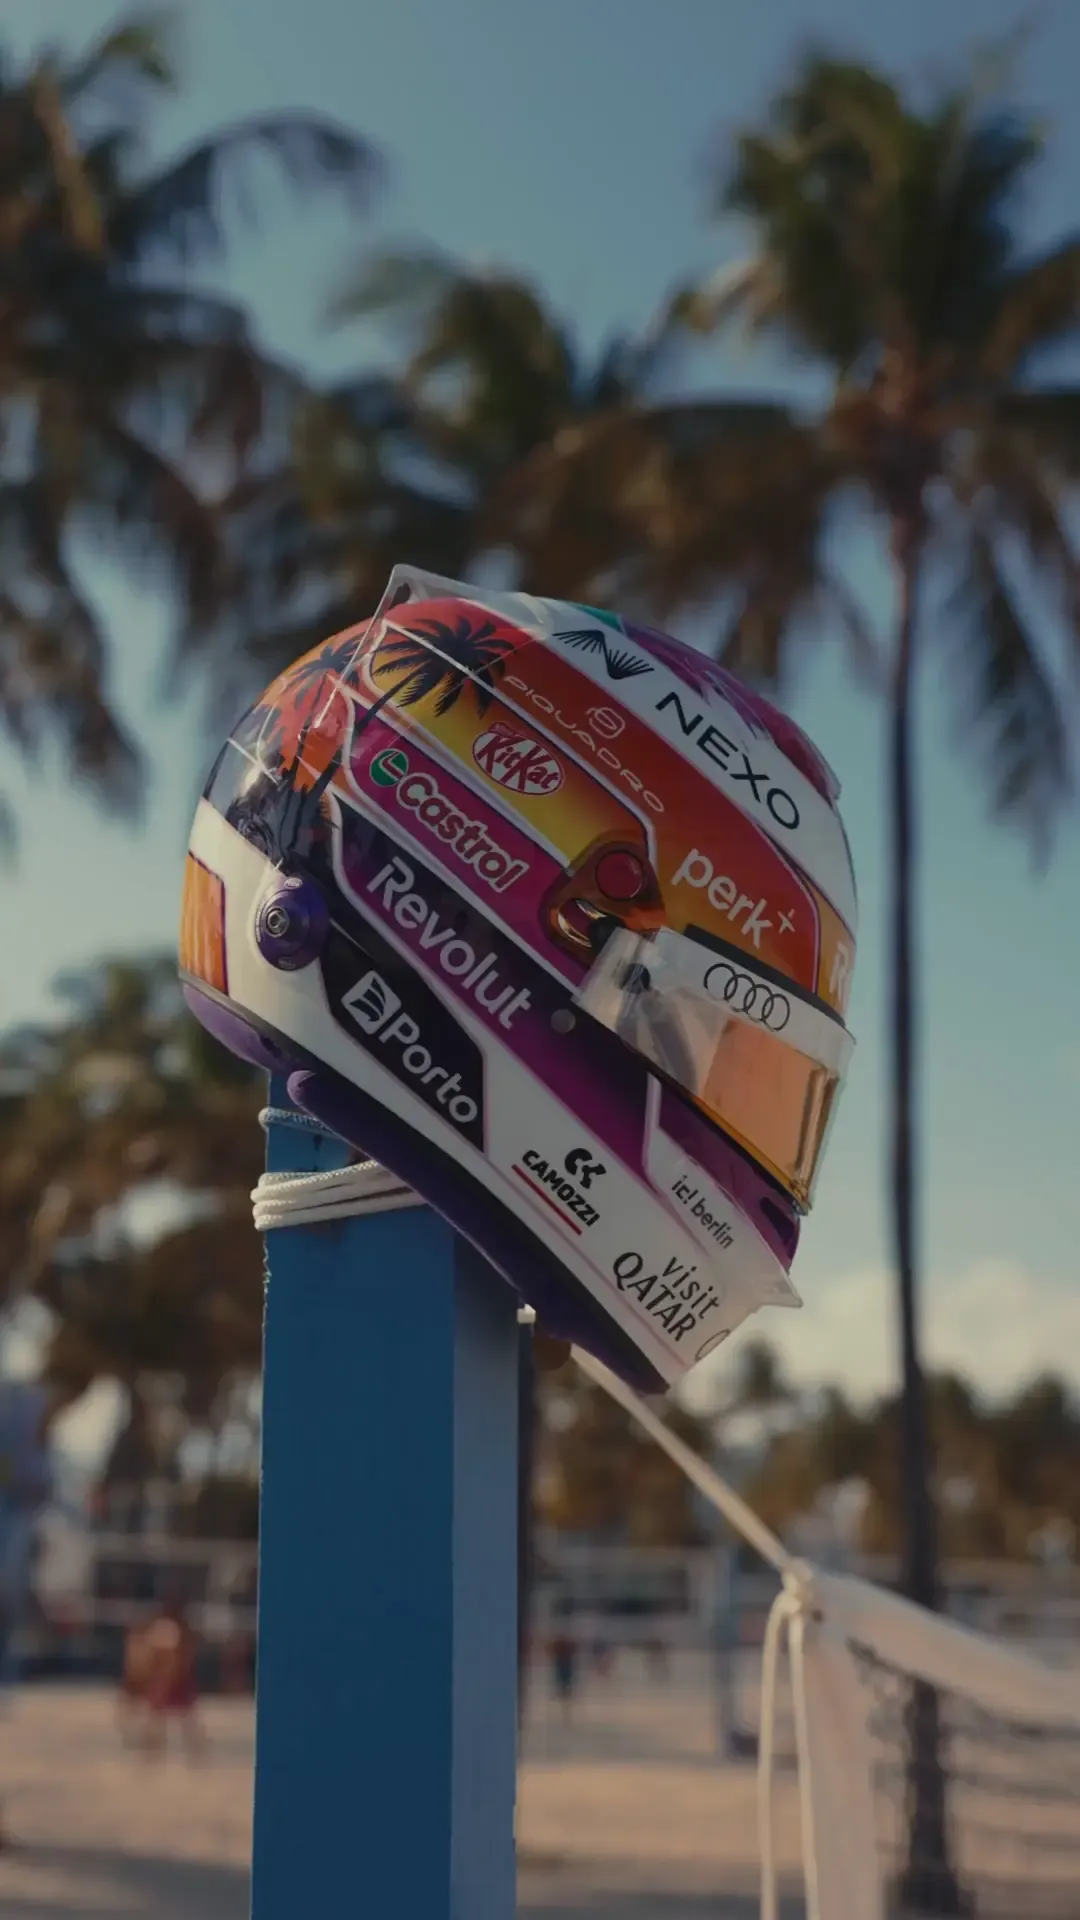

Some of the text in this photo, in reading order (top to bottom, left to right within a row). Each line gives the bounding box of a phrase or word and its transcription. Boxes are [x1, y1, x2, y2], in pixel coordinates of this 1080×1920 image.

[476, 734, 561, 791] KitKat
[504, 675, 665, 813] PIQUADRO
[655, 692, 800, 830] NEXO
[397, 773, 530, 893] Castrol
[366, 856, 531, 1029] Revolut
[378, 1013, 478, 1123] Porto
[522, 1150, 601, 1227] CAMOZZI
[690, 1197, 735, 1250] berlin
[612, 1251, 697, 1342] QATAR
[662, 1256, 719, 1319] visit
